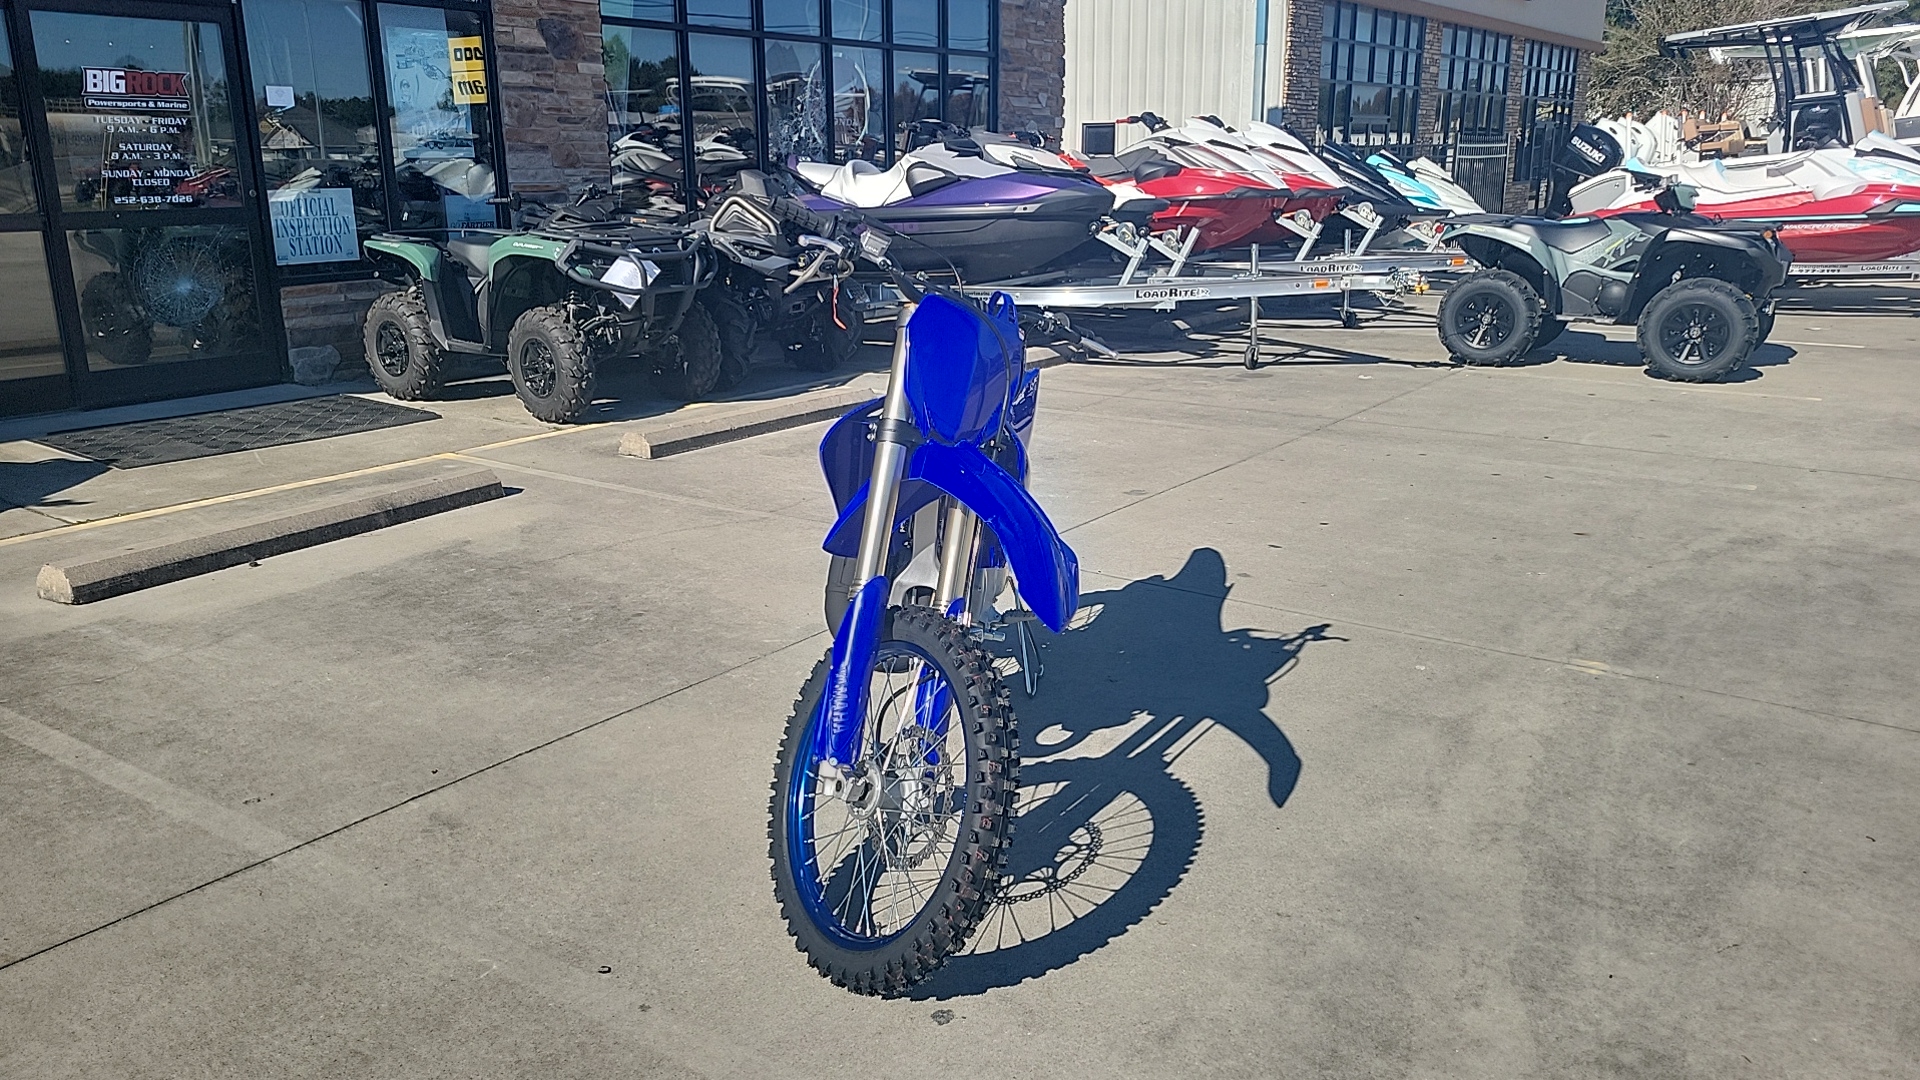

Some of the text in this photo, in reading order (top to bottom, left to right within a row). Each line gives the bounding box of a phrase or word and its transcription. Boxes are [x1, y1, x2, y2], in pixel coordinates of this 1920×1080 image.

[88, 98, 146, 109] Powersports
[157, 101, 187, 109] Marine
[95, 116, 139, 125] TUESDAY
[152, 117, 188, 126] FRIDAY
[118, 126, 139, 134] A.M.
[119, 143, 173, 151] SATURDAY
[1570, 135, 1606, 163] SUZUKI
[111, 152, 119, 160] 8
[122, 152, 143, 160] A.M.
[153, 152, 160, 160] 3
[163, 152, 184, 160] P.M.
[102, 169, 143, 178] SUNDAY
[153, 169, 195, 177] MONDAY
[132, 178, 170, 186] CLOSED
[114, 195, 193, 204] 252-638-7026
[280, 198, 339, 218] OFFICIAL
[275, 216, 351, 238] INSPECTION
[461, 221, 495, 229] FARTHER
[288, 235, 343, 257] STATION
